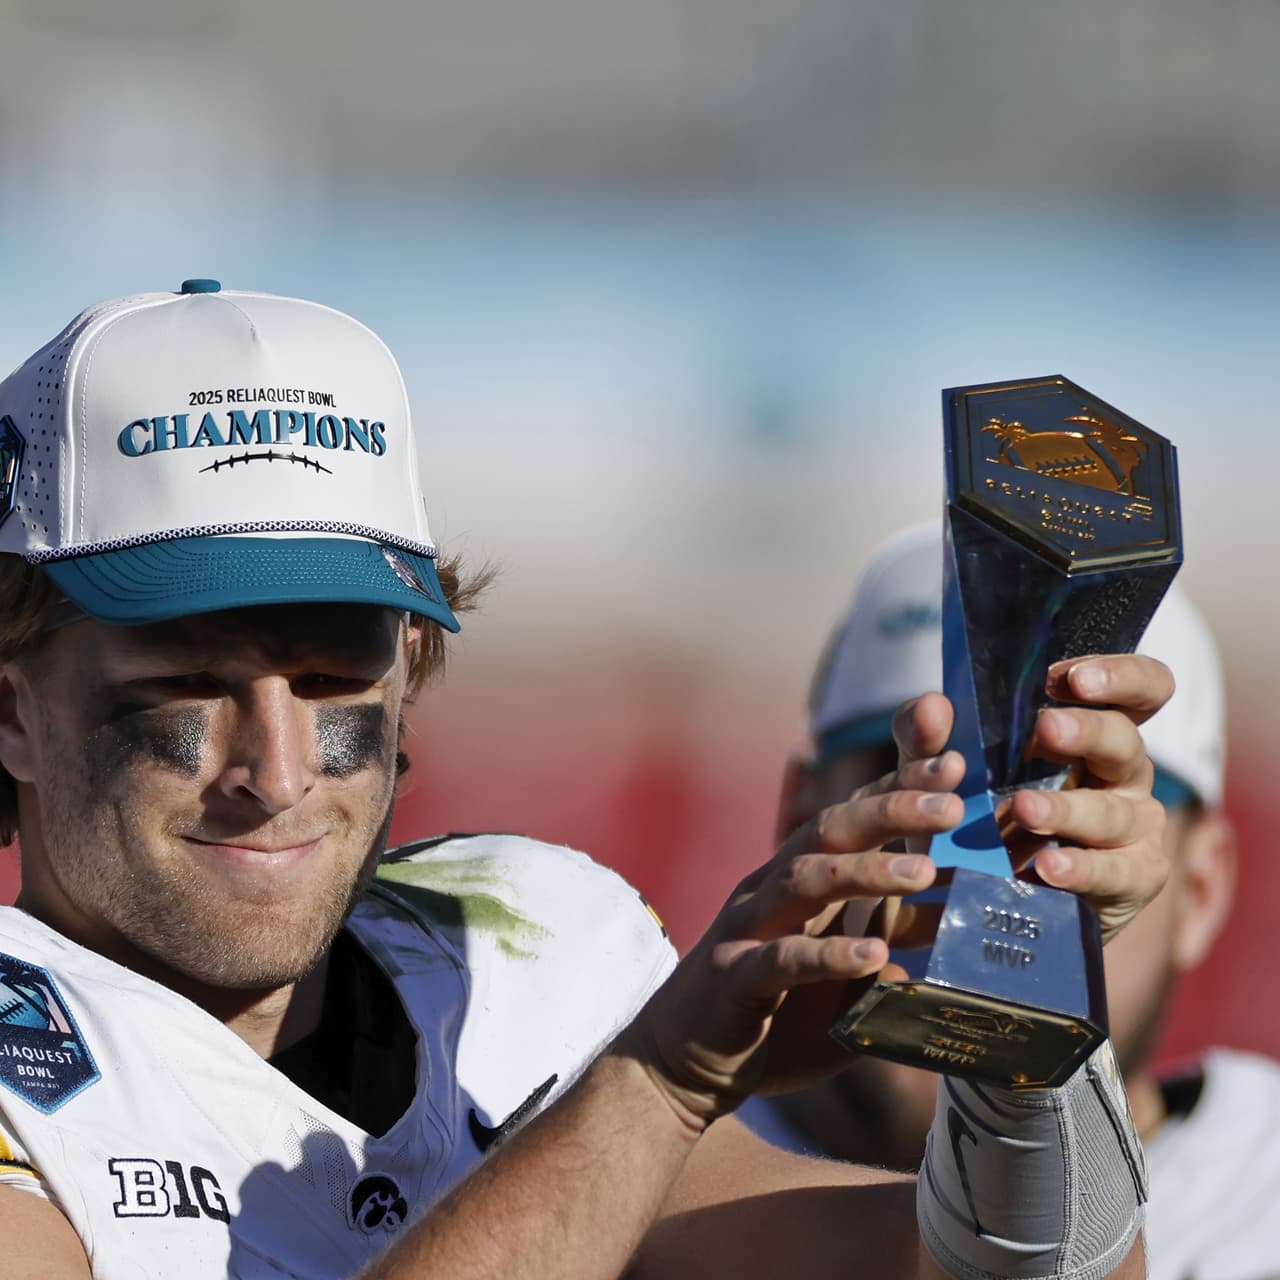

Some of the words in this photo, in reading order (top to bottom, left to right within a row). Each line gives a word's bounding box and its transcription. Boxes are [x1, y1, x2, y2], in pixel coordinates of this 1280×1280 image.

[189, 391, 223, 406] 2025
[227, 388, 305, 403] RELIAQUEST
[308, 391, 336, 407] BOWL
[119, 409, 387, 457] CHAMPIONS
[983, 905, 1039, 940] 2025
[982, 937, 1035, 970] MVP
[17, 1064, 55, 1079] BOWL
